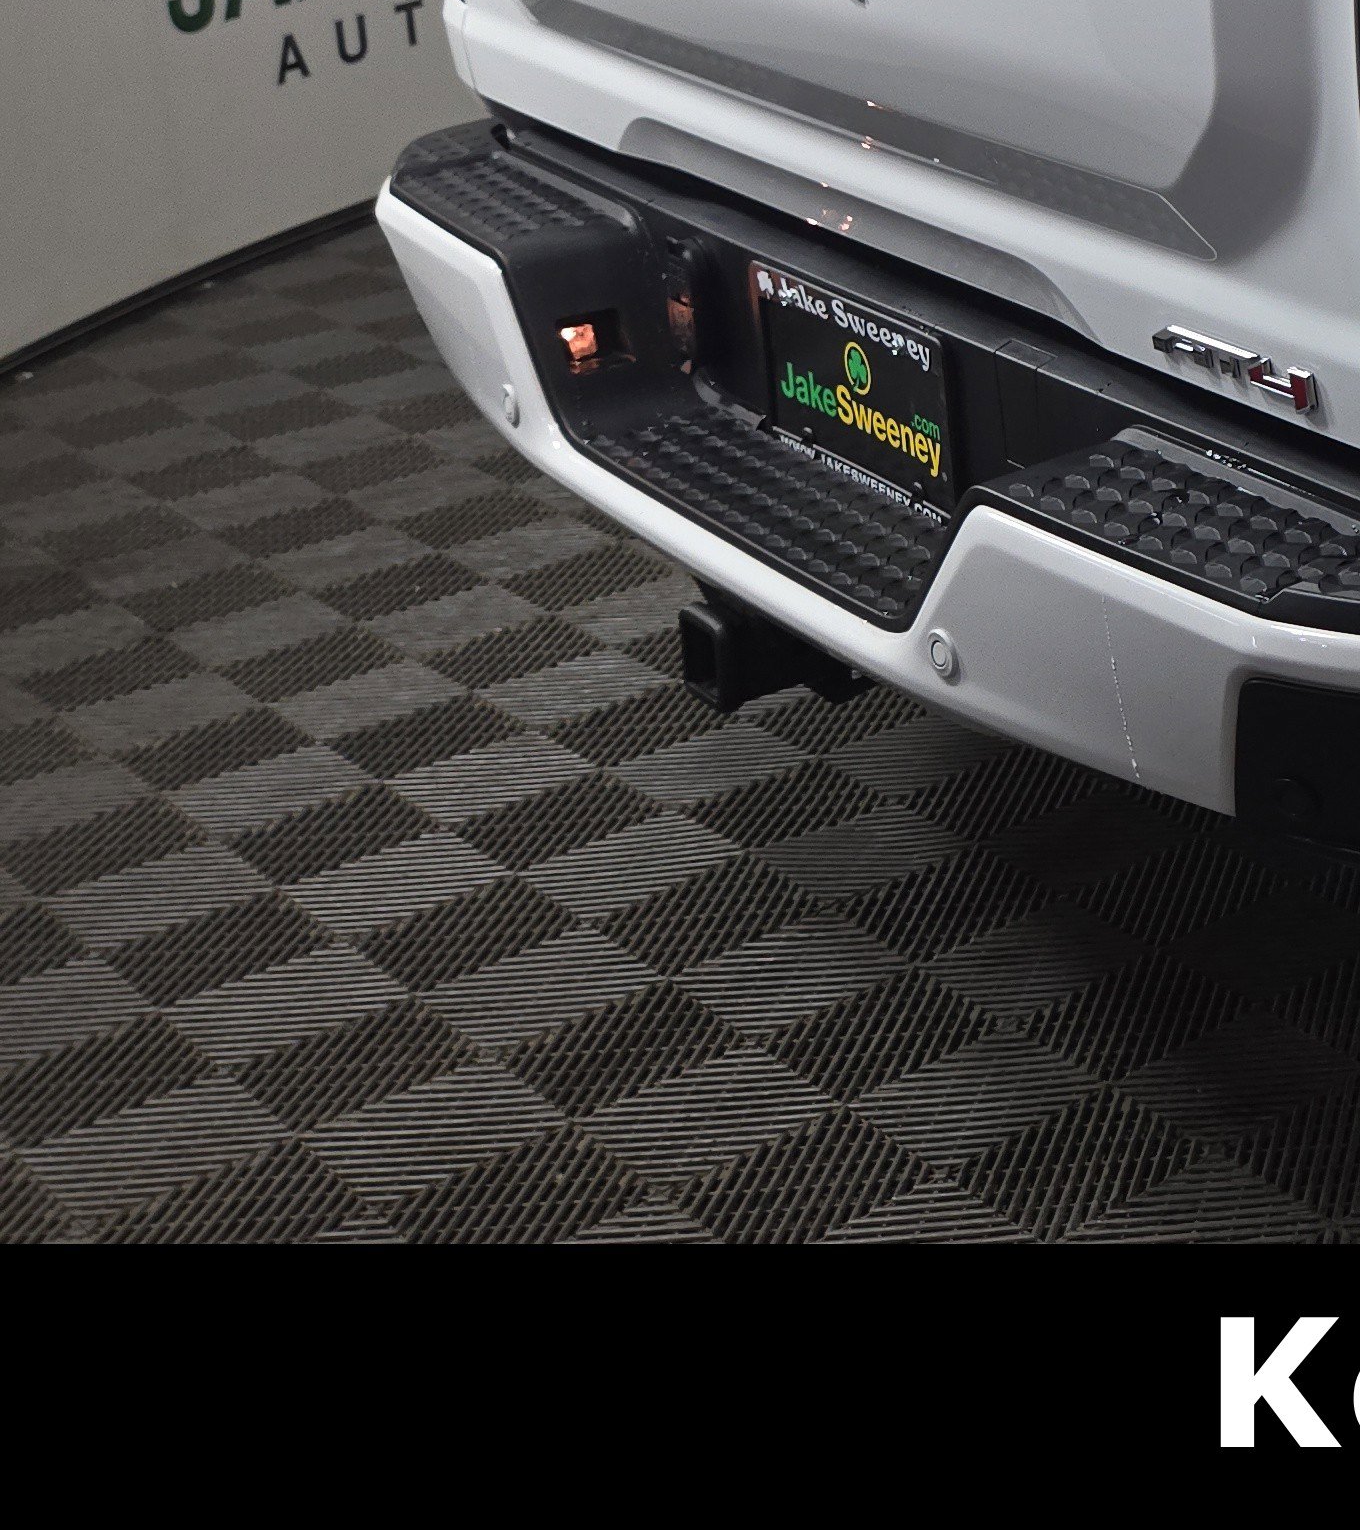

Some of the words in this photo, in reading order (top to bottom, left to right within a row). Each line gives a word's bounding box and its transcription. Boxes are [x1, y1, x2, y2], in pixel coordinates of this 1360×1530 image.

[779, 278, 829, 320] Jake
[831, 299, 930, 372] Sweeney
[911, 414, 941, 441] .com
